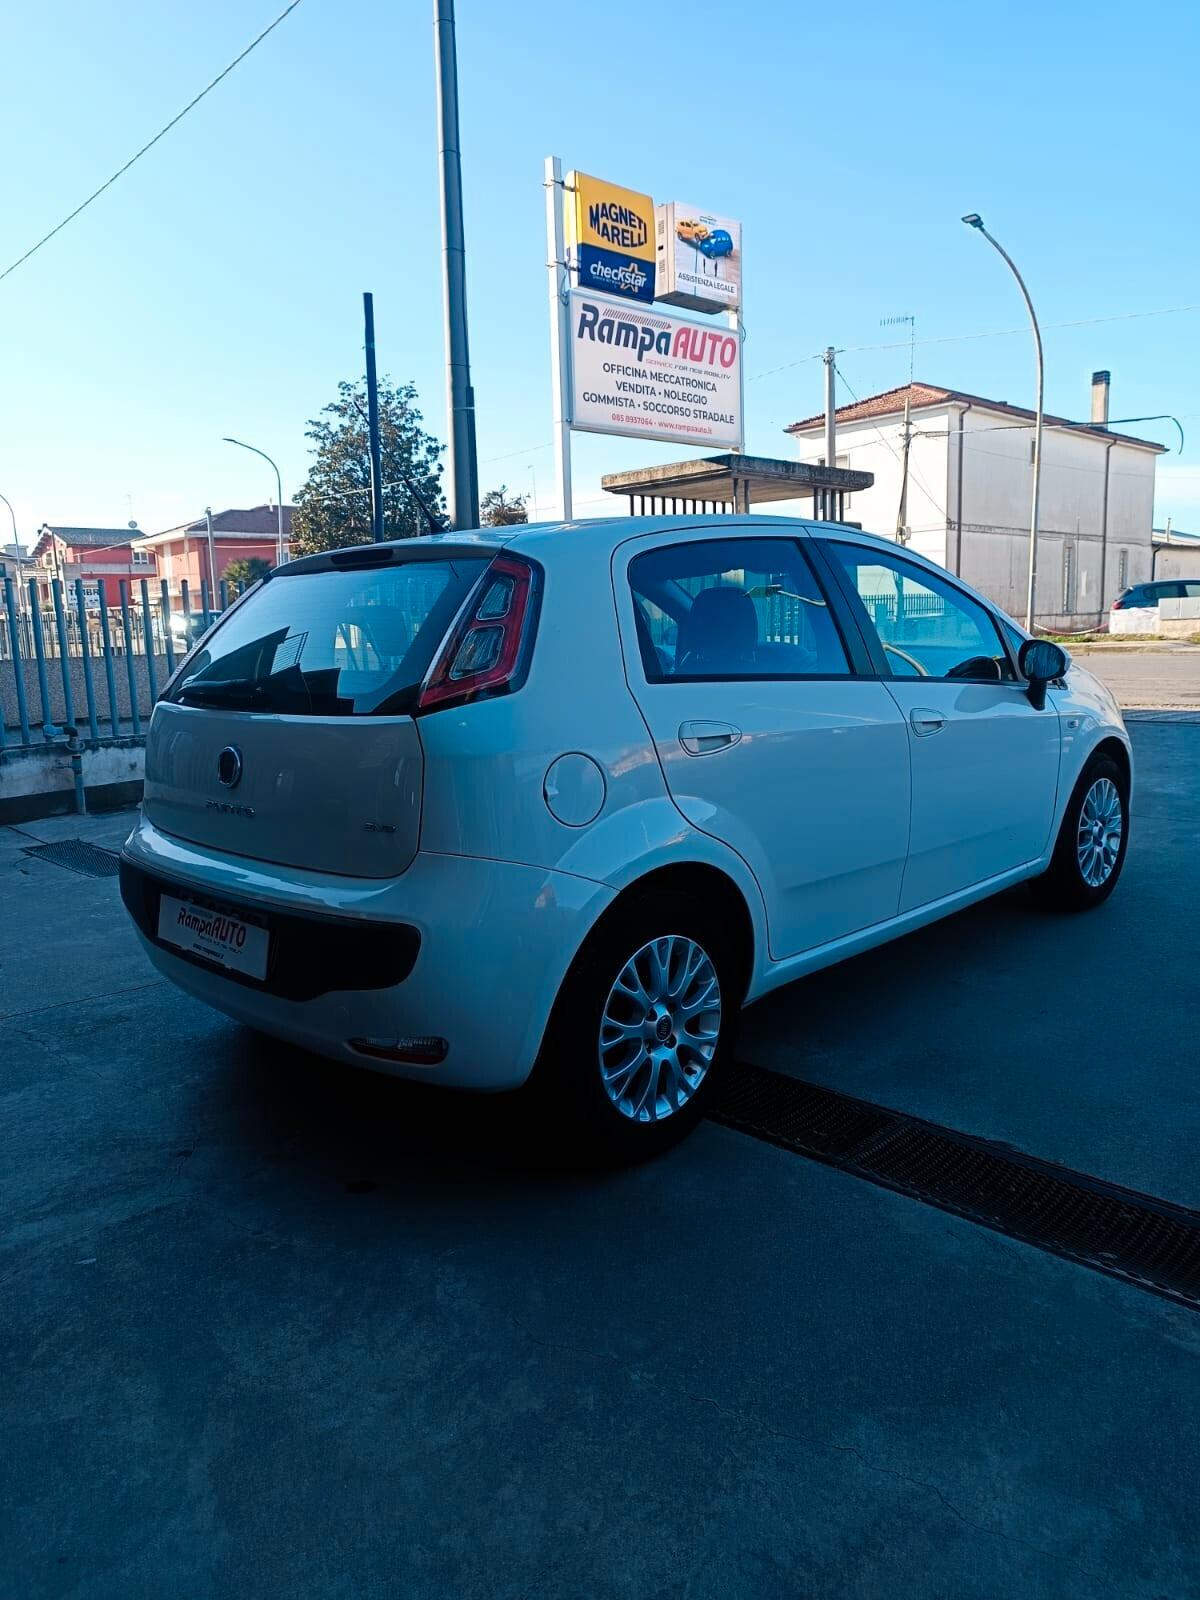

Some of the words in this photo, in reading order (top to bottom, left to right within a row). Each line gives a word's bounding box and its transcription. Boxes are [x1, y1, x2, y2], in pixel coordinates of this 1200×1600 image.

[589, 202, 647, 233] MAGNETI
[589, 219, 647, 248] MARELLI
[590, 261, 647, 288] checkstar
[678, 272, 713, 288] ASSISTENZA
[713, 282, 735, 293] LEGALE
[602, 362, 648, 380] OFFICINA
[650, 372, 717, 393] MECCATRONICA
[615, 381, 657, 397] VENDITA
[664, 390, 708, 406] NOLEGGIO
[583, 392, 636, 409] GOMMISTA
[642, 401, 691, 418] SOCCORSO
[692, 409, 735, 425] STRADALE
